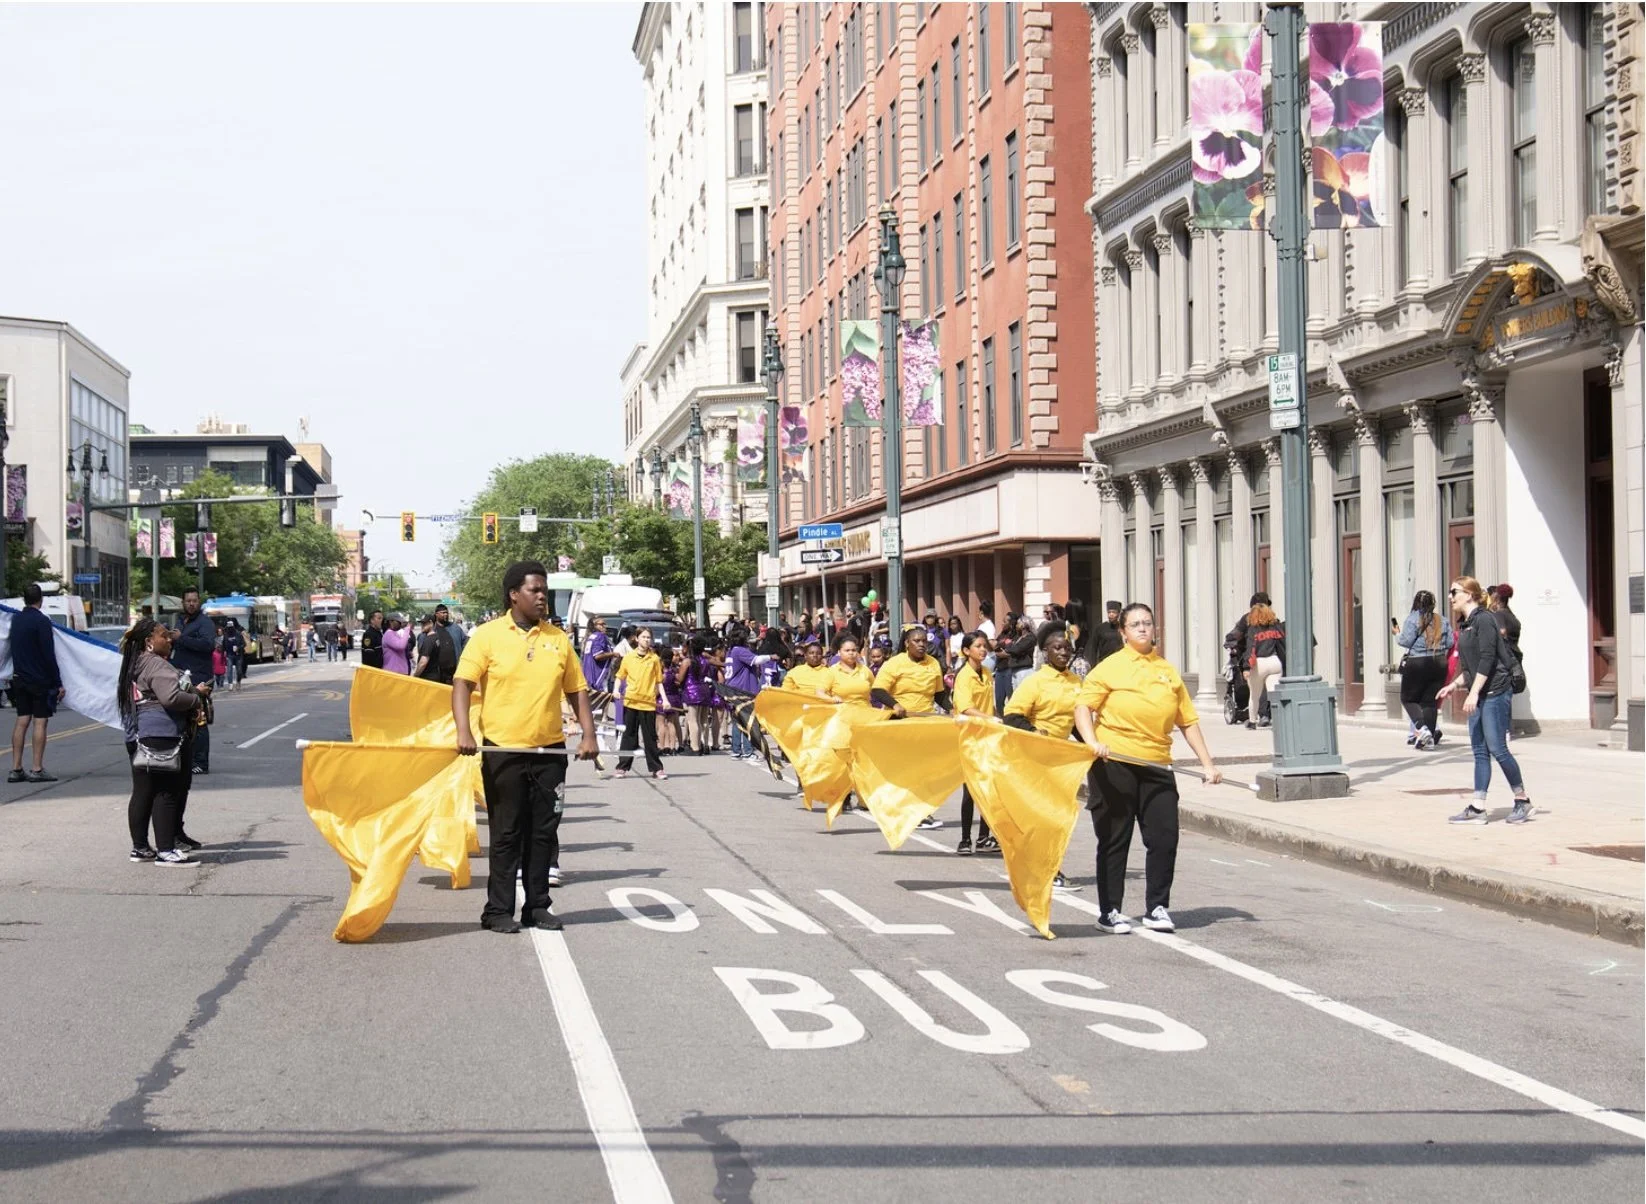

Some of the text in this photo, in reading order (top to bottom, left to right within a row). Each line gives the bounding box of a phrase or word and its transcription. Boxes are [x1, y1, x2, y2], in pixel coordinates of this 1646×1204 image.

[1271, 356, 1278, 370] 15
[1276, 384, 1291, 395] 6PM
[802, 527, 828, 537] Pindle
[607, 886, 1035, 935] ONLY
[711, 966, 1209, 1055] BUS
